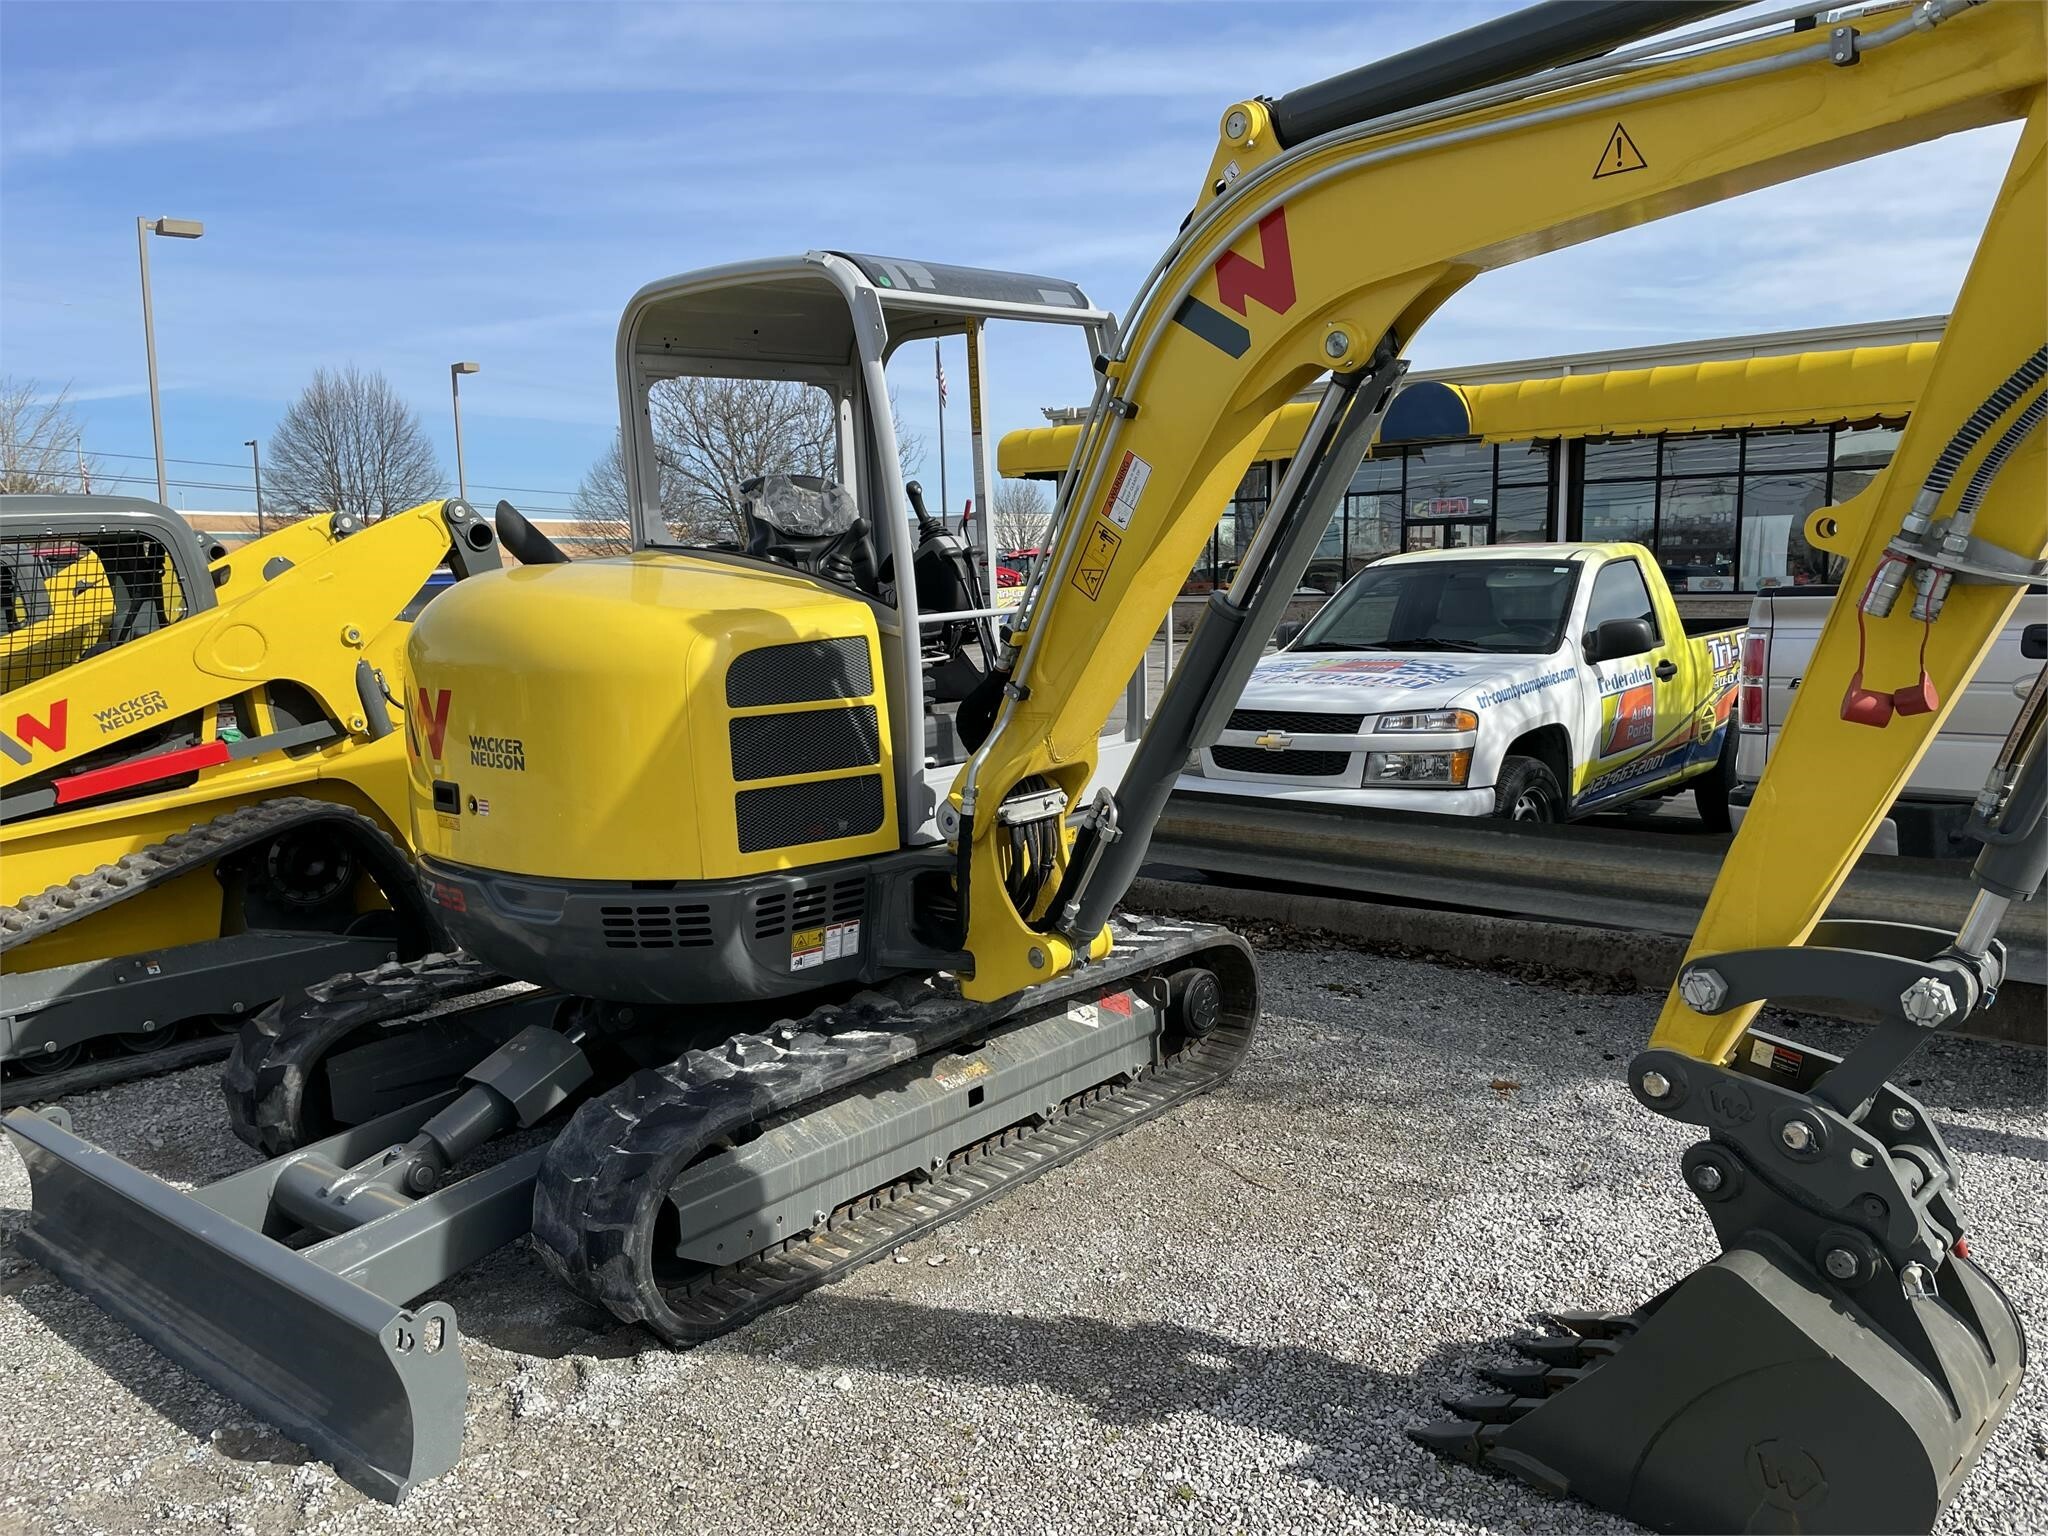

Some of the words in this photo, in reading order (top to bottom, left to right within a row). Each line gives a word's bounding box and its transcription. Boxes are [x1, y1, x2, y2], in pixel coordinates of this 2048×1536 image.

[1111, 460, 1130, 500] WARNING
[1476, 666, 1577, 709] tri-countycompanies.com
[93, 690, 163, 723] WACKER
[99, 699, 169, 734] NEUSON
[1632, 704, 1652, 721] Auto
[1627, 723, 1652, 739] Parts
[469, 735, 524, 755] WACKER
[470, 751, 525, 771] NEUSON
